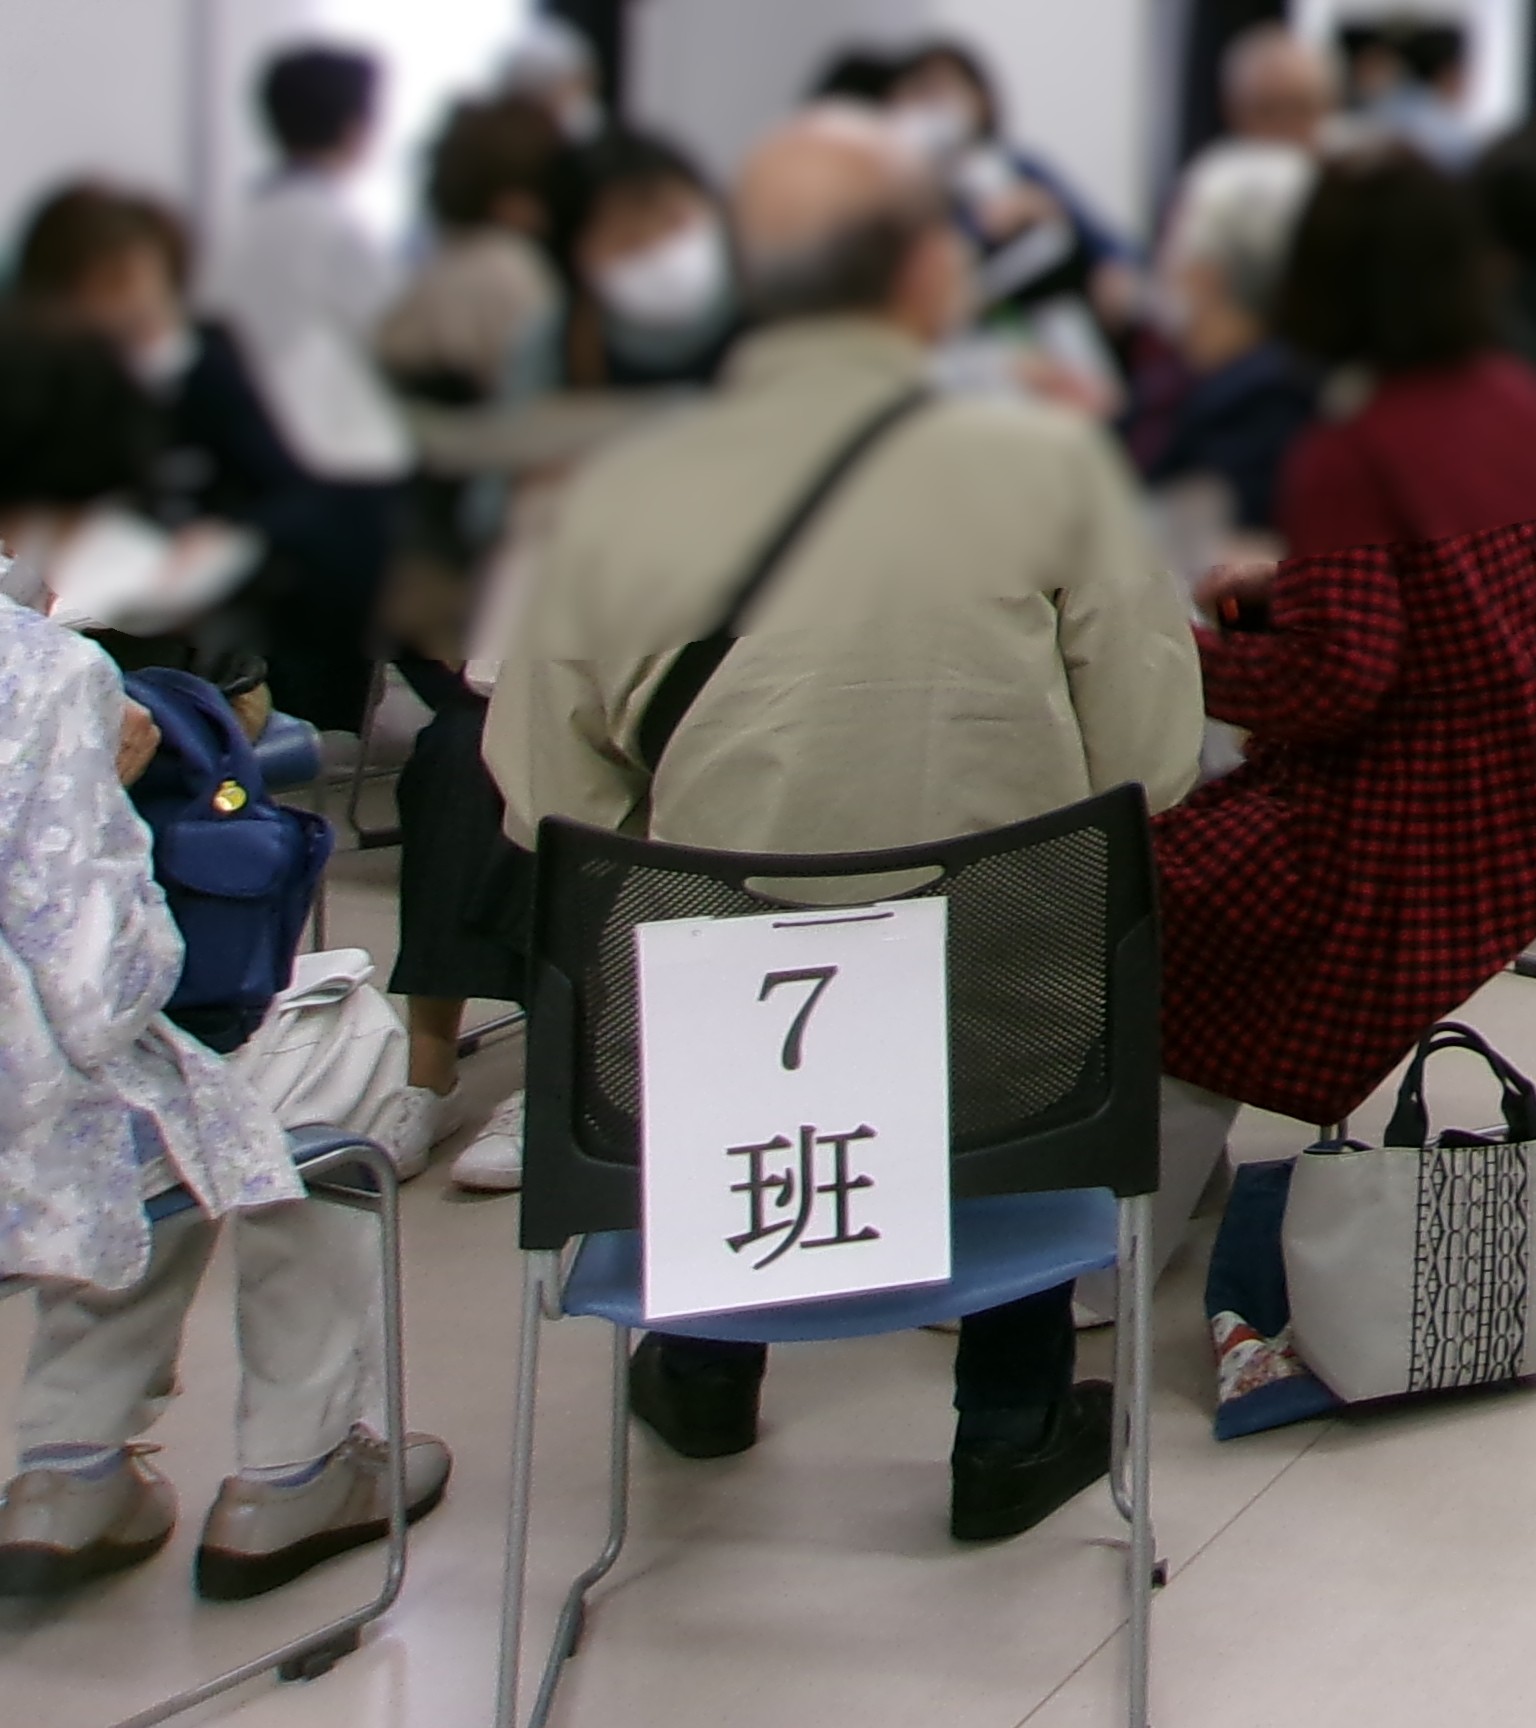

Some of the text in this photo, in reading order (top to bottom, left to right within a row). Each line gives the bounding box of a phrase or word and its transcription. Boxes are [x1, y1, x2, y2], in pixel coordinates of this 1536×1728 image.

[1417, 1146, 1528, 1178] FAUCHON
[1416, 1200, 1528, 1232] FAUCHON
[1414, 1254, 1528, 1287] FAUCHON
[1411, 1306, 1526, 1342] FAUCHON
